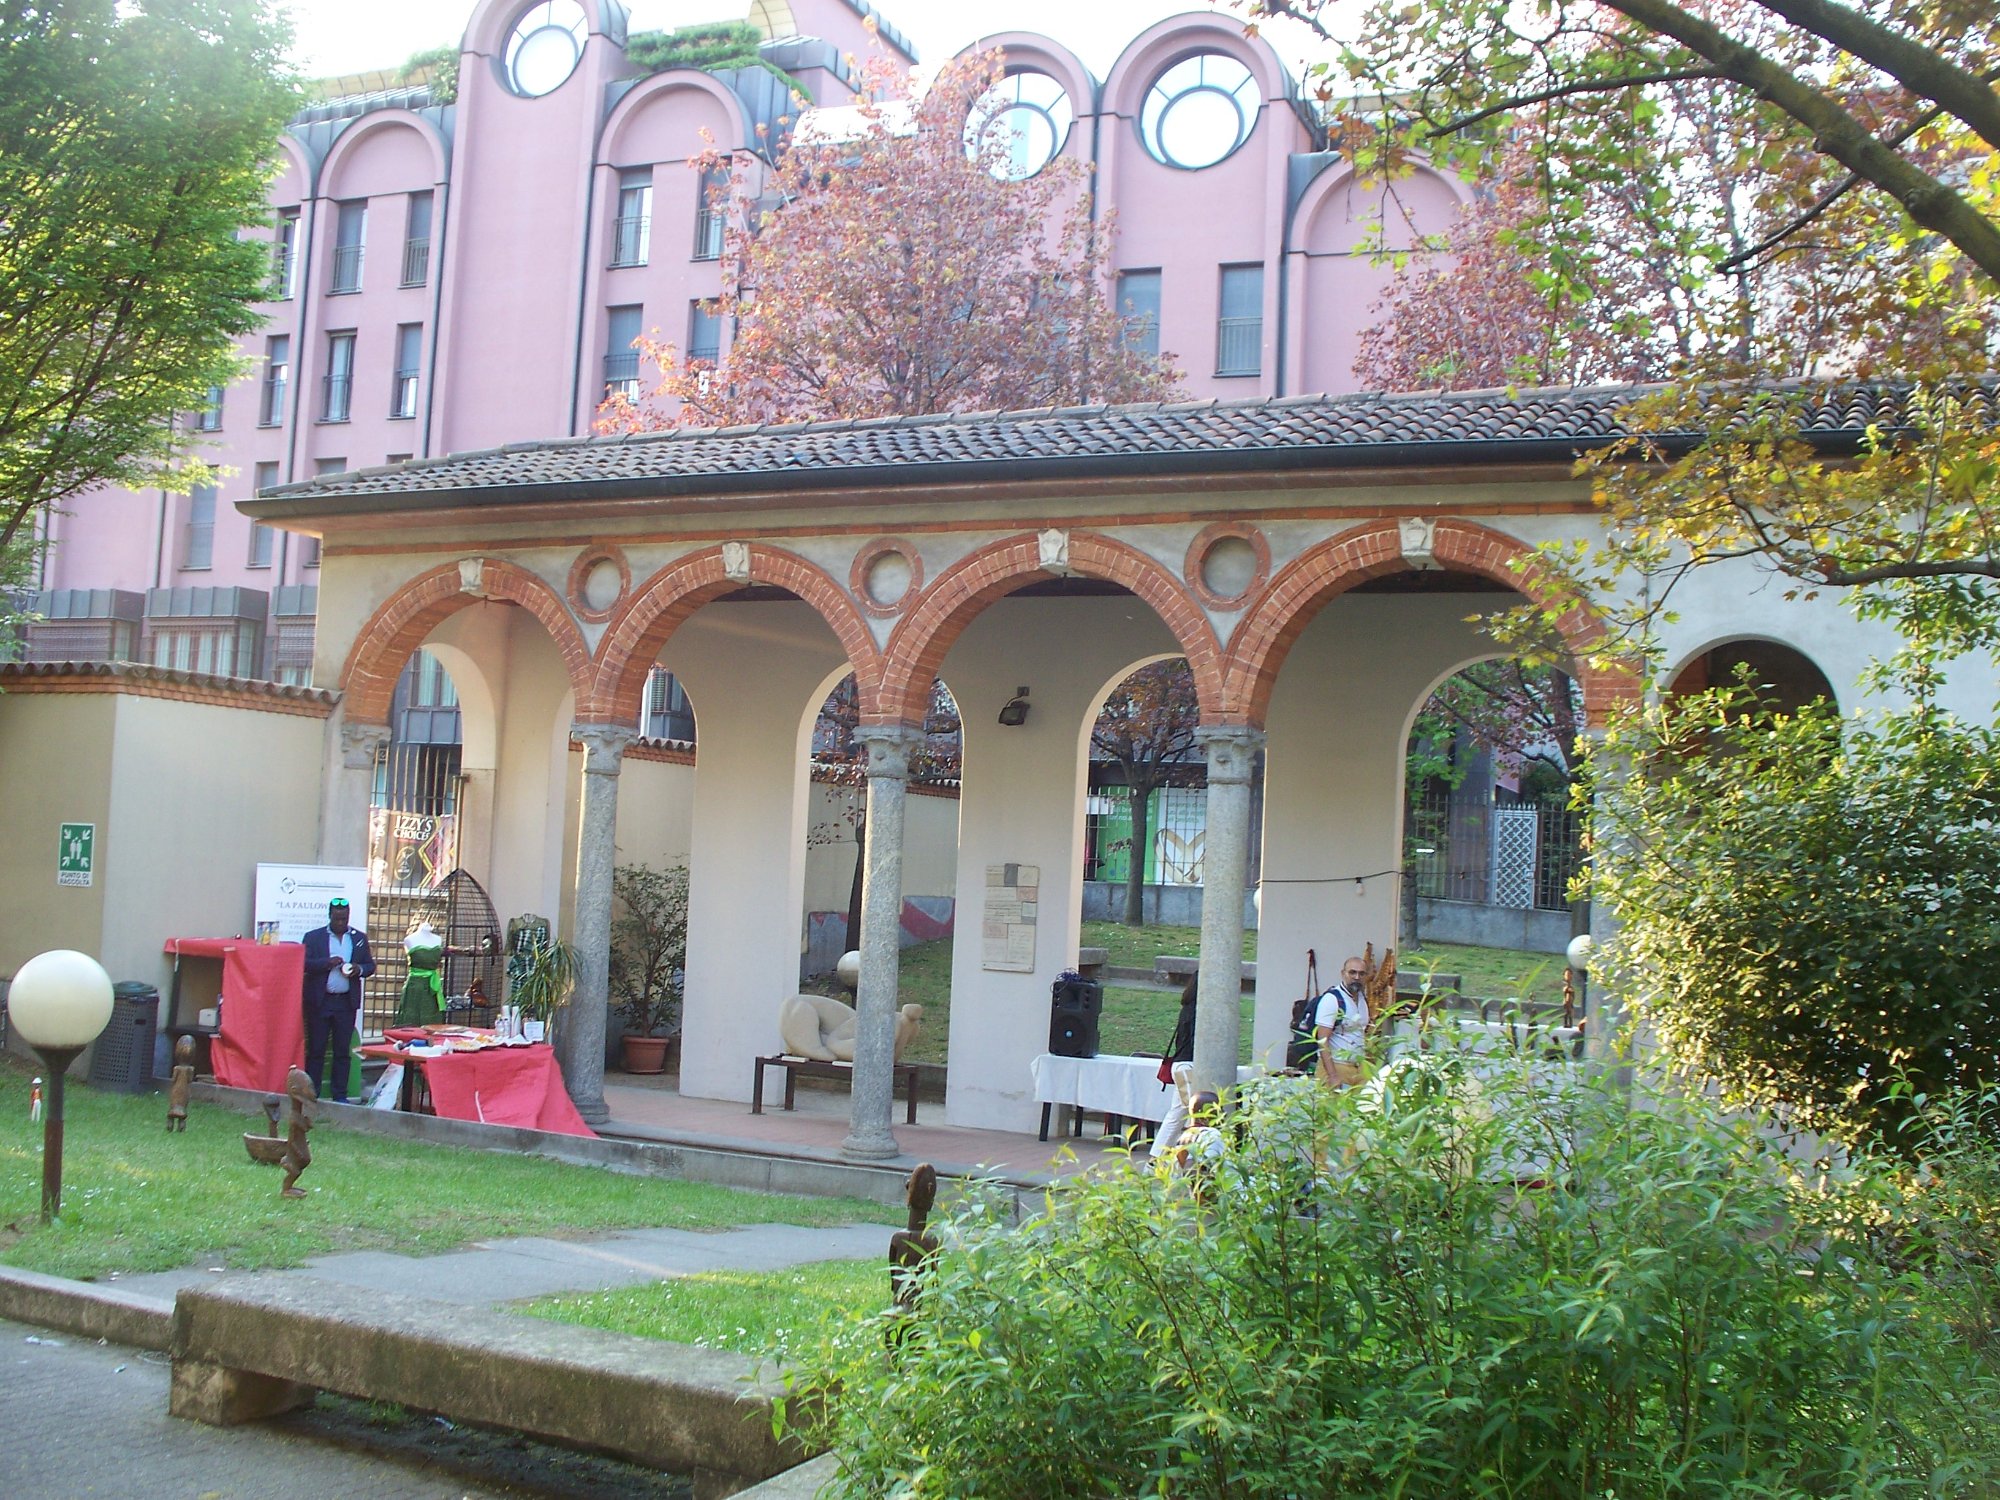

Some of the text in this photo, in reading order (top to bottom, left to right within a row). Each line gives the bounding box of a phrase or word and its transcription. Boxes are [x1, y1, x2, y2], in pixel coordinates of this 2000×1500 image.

[395, 815, 434, 832] IZZY'S
[393, 828, 431, 841] CHOICES
[61, 871, 81, 879] PUNTO
